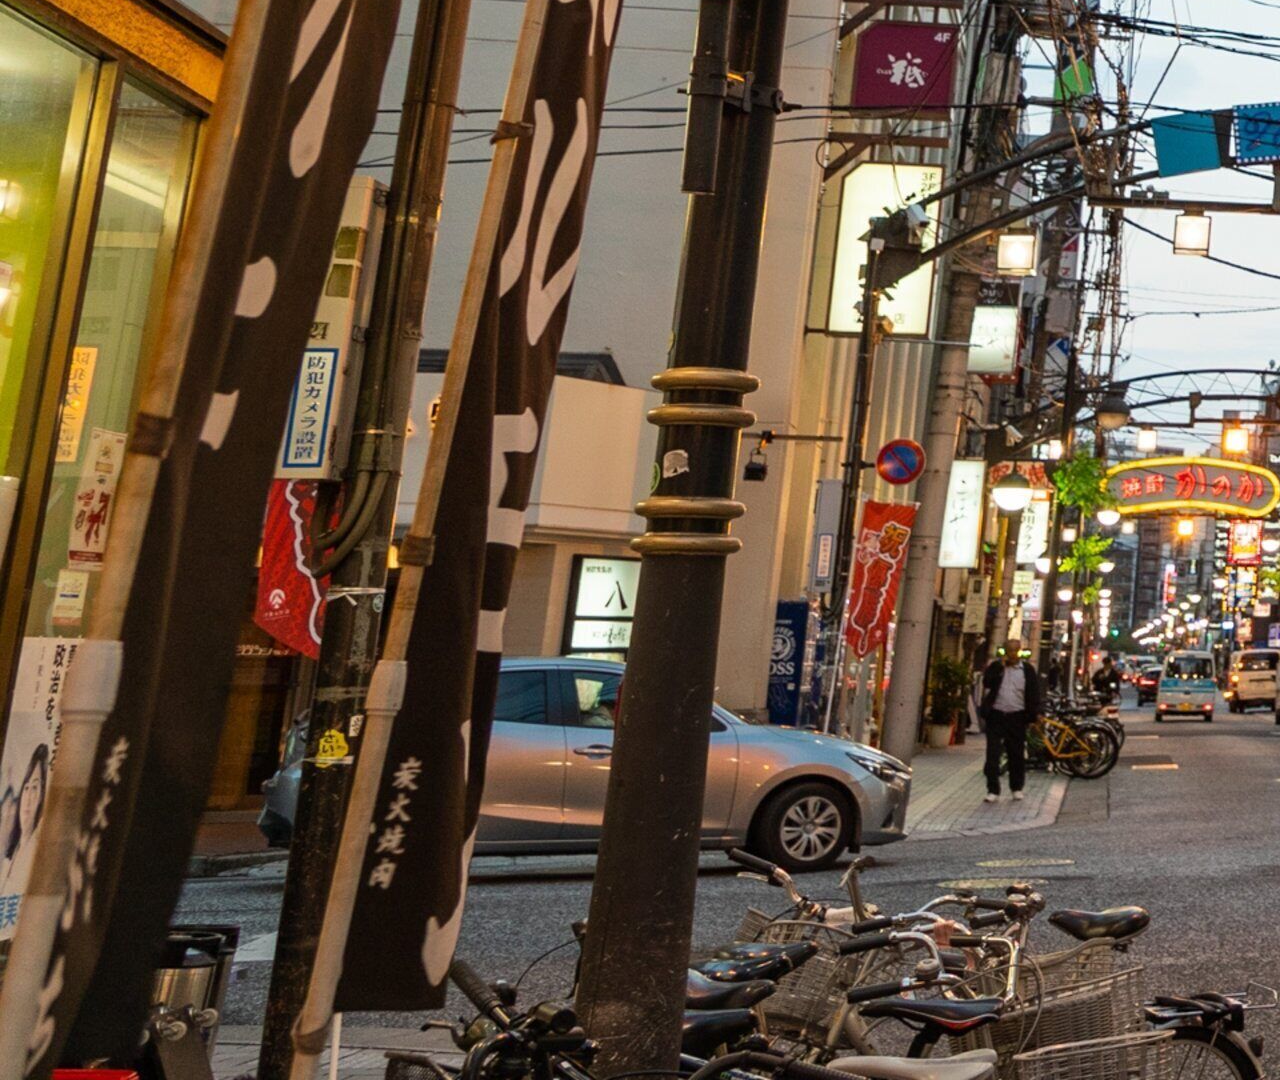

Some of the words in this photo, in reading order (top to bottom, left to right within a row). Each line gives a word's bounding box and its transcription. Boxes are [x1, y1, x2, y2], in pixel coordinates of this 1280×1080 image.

[933, 31, 951, 43] 4F
[295, 355, 327, 460] 防犯カメラ設置
[1173, 465, 1264, 505] かのか
[369, 756, 422, 890] 炭火焼肉
